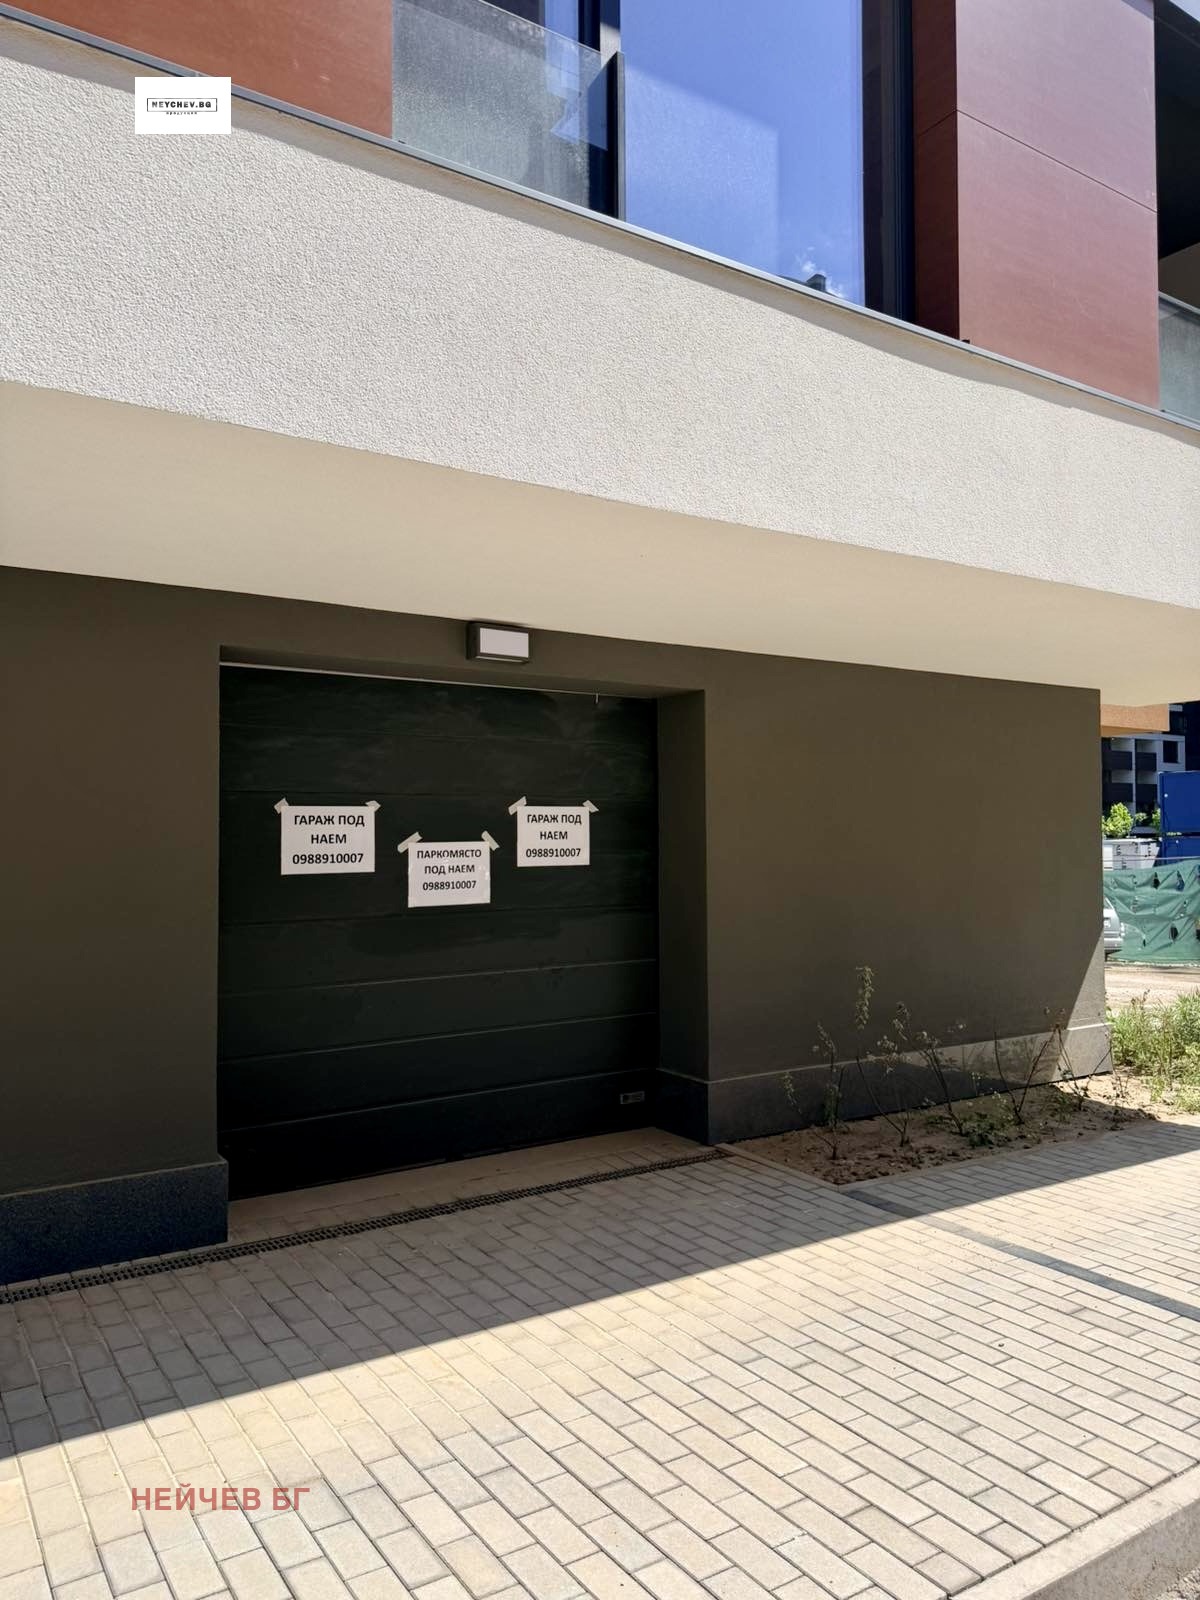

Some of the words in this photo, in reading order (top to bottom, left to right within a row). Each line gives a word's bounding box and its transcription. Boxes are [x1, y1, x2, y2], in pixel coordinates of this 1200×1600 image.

[294, 815, 335, 825] ГАРАЖ
[338, 815, 365, 827] ПОД
[527, 814, 559, 823] ГАРАЖ
[561, 814, 582, 825] ПОД
[311, 834, 347, 844] НАЕМ
[540, 831, 568, 840] НАЕМ
[416, 849, 482, 859] ПАРКОМЯСТО
[526, 848, 581, 857] 0988910007
[292, 853, 364, 864] 0988910007
[424, 865, 446, 875] ПОД
[448, 864, 475, 873] НАЕМ
[422, 880, 477, 890] 0988910007
